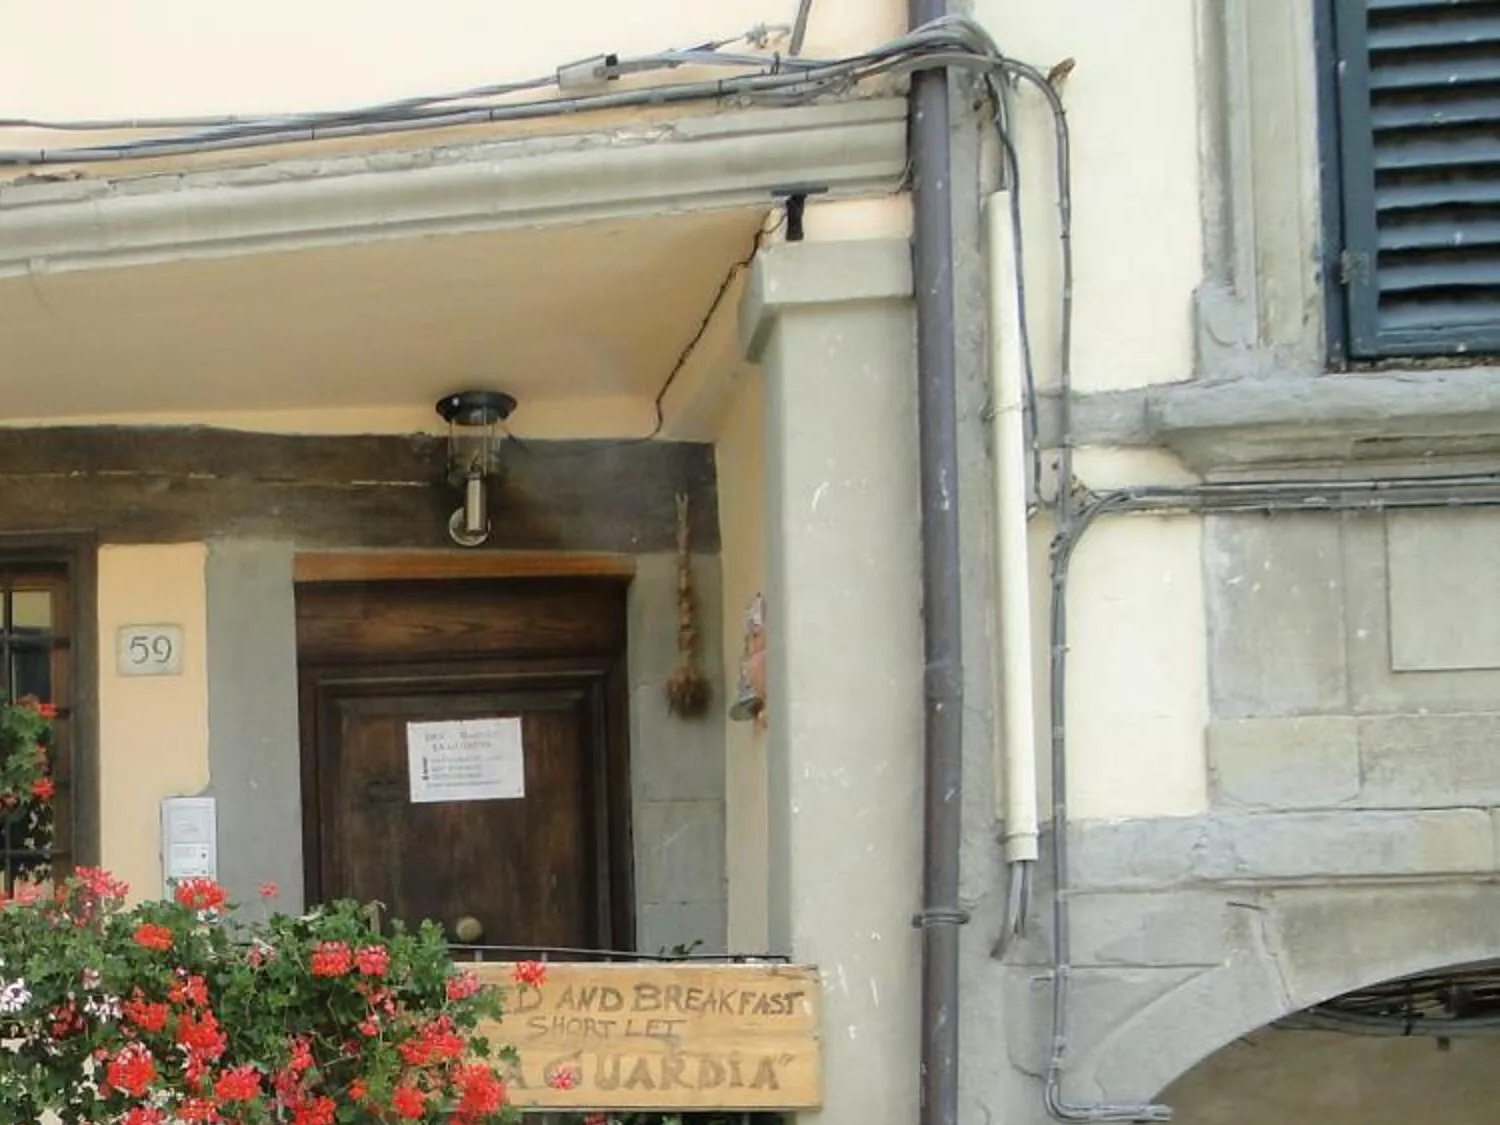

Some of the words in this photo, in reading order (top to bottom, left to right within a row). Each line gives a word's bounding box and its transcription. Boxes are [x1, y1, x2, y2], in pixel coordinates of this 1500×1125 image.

[129, 635, 173, 665] 59
[555, 984, 625, 1012] AND
[630, 983, 805, 1017] BREAKFAST
[524, 1014, 617, 1040] SHORT
[624, 1017, 687, 1039] LET
